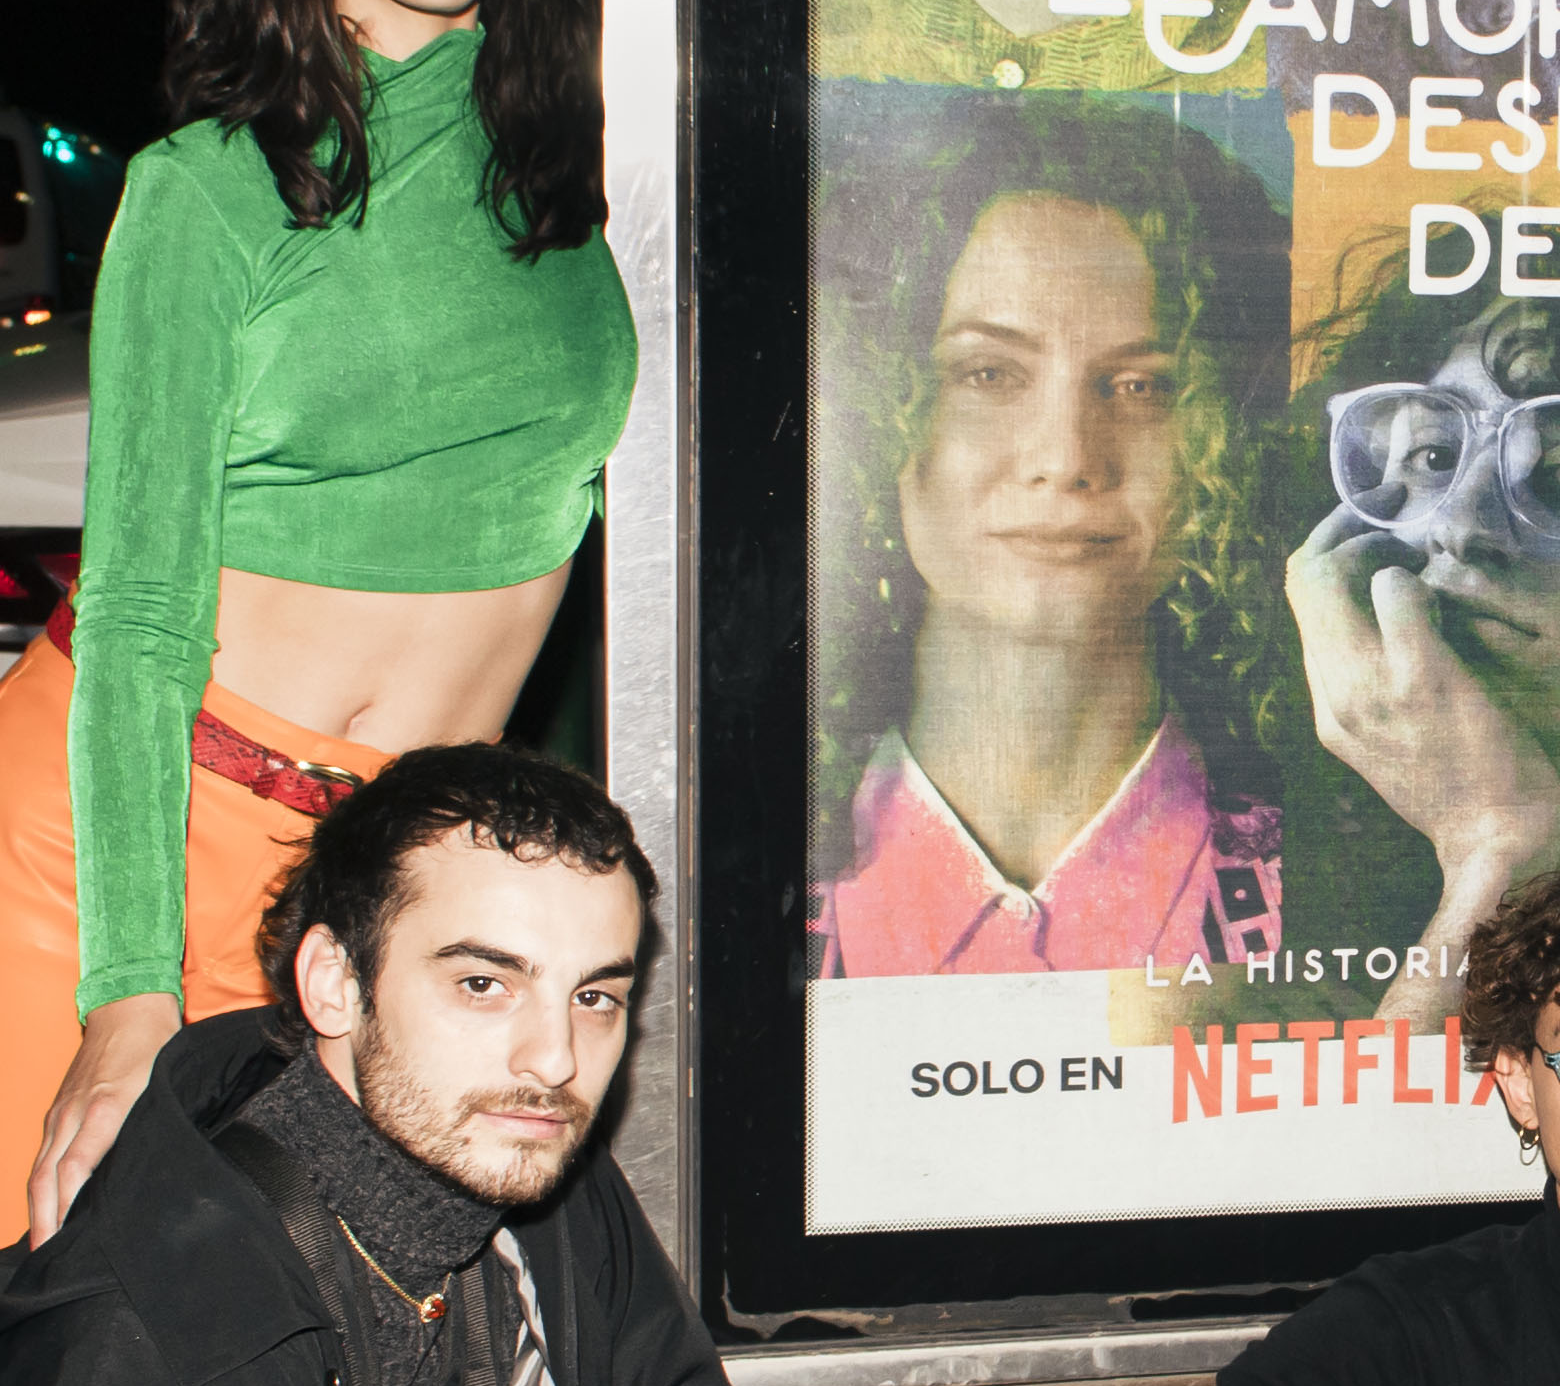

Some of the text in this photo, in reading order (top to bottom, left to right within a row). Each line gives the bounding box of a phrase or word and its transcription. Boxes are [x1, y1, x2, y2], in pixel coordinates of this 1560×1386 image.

[1146, 953, 1223, 987] LA
[910, 1056, 1043, 1099] SOLO
[1060, 1051, 1124, 1093] EN
